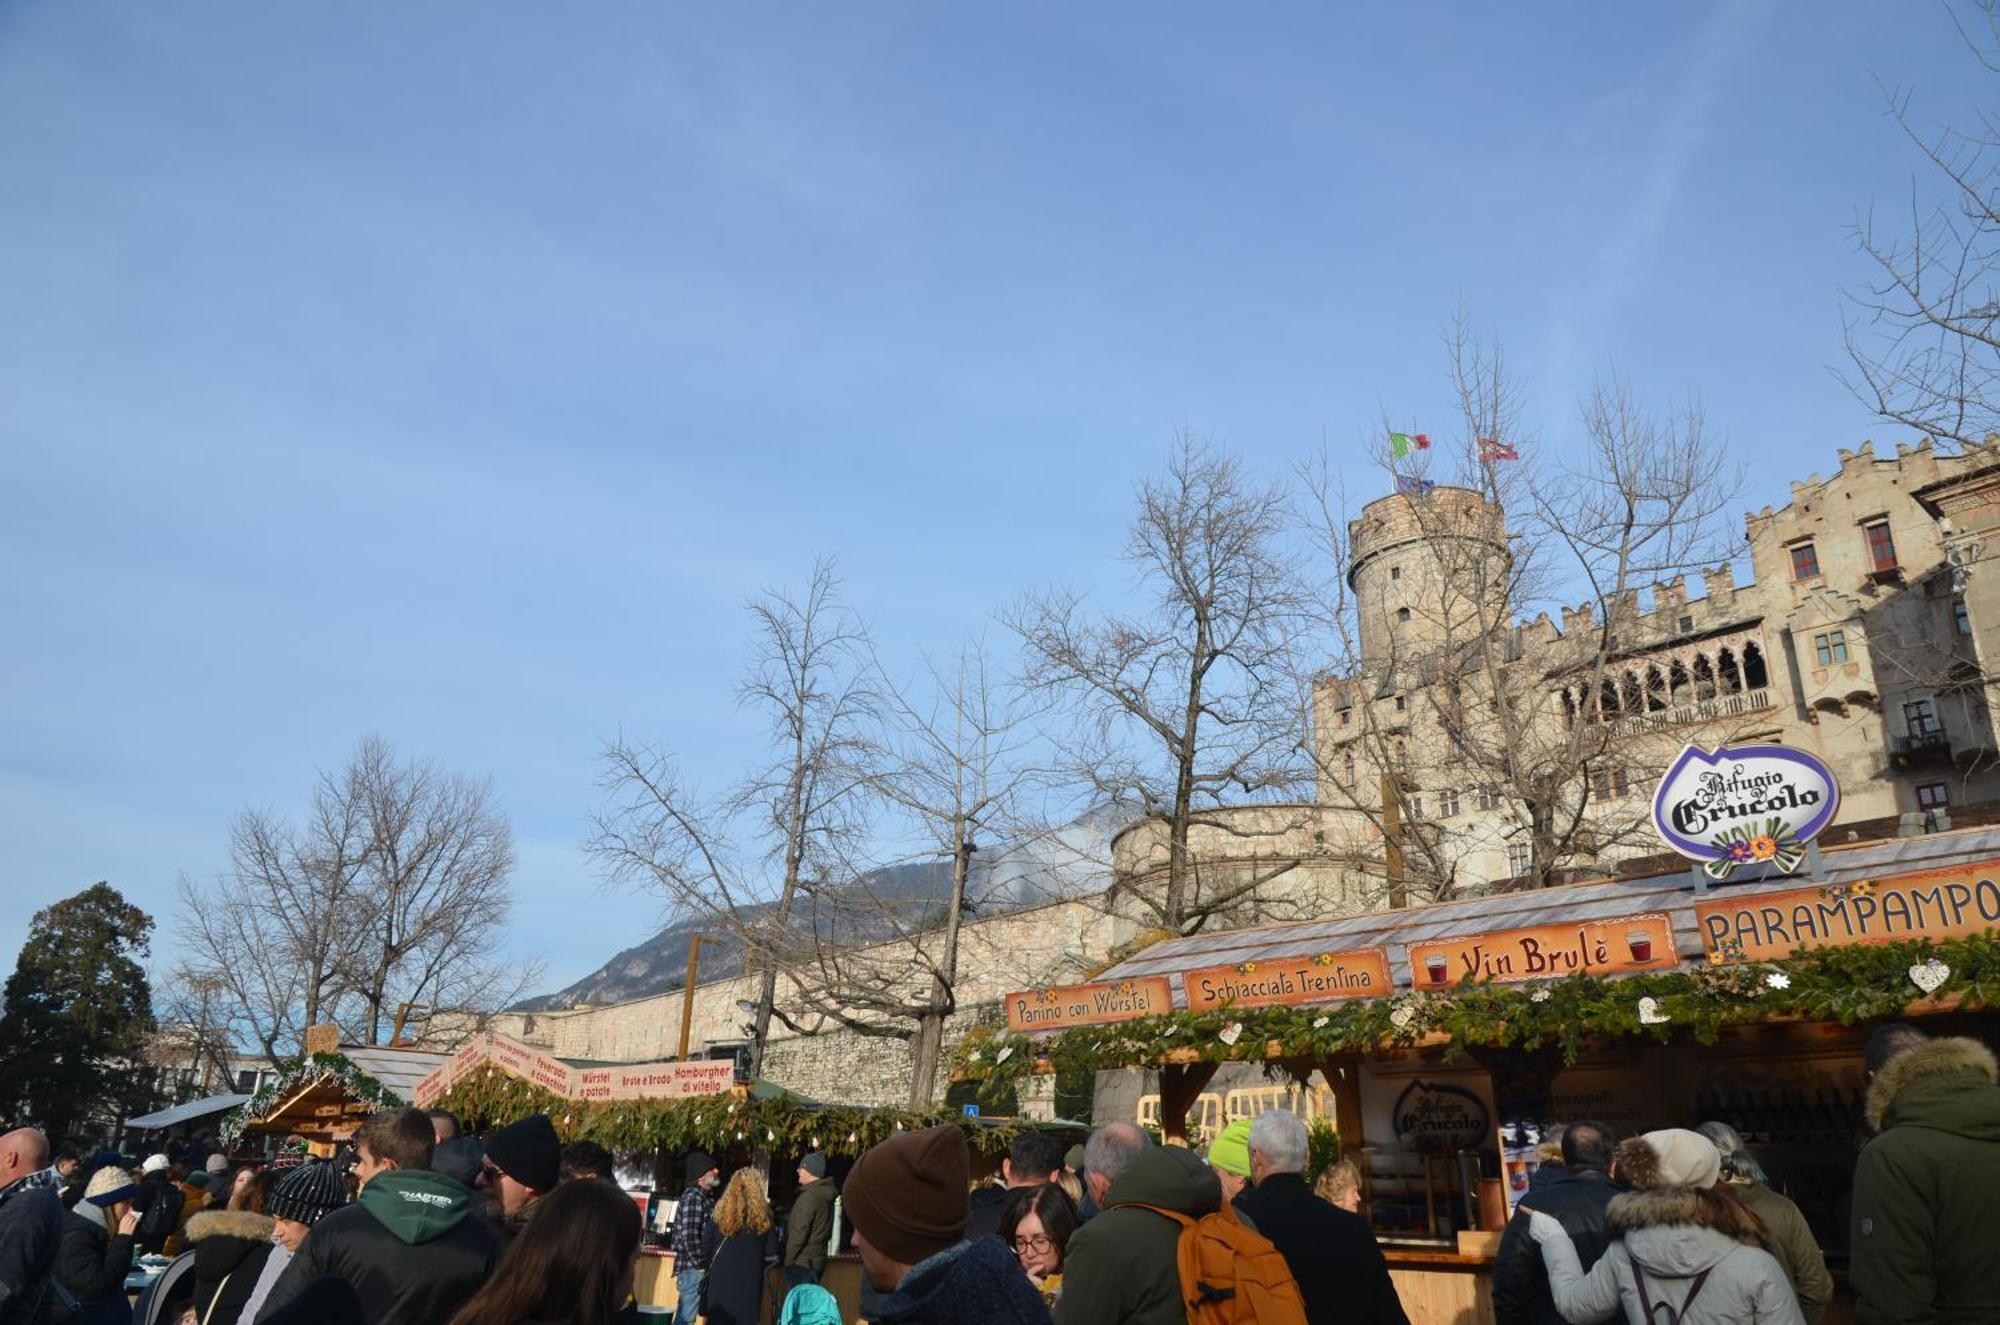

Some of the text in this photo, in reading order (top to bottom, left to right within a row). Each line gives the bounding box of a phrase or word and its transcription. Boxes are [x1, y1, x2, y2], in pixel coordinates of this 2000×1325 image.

[1699, 764, 1784, 799] Rifugio
[1672, 784, 1820, 835] Crucolo
[1705, 879, 2000, 950] PARAMPAMPO
[1461, 944, 1513, 977] Vin
[1201, 966, 1372, 1001] Schiacciata Trentina
[1017, 1000, 1062, 1024] Panino
[1068, 1003, 1090, 1017] con
